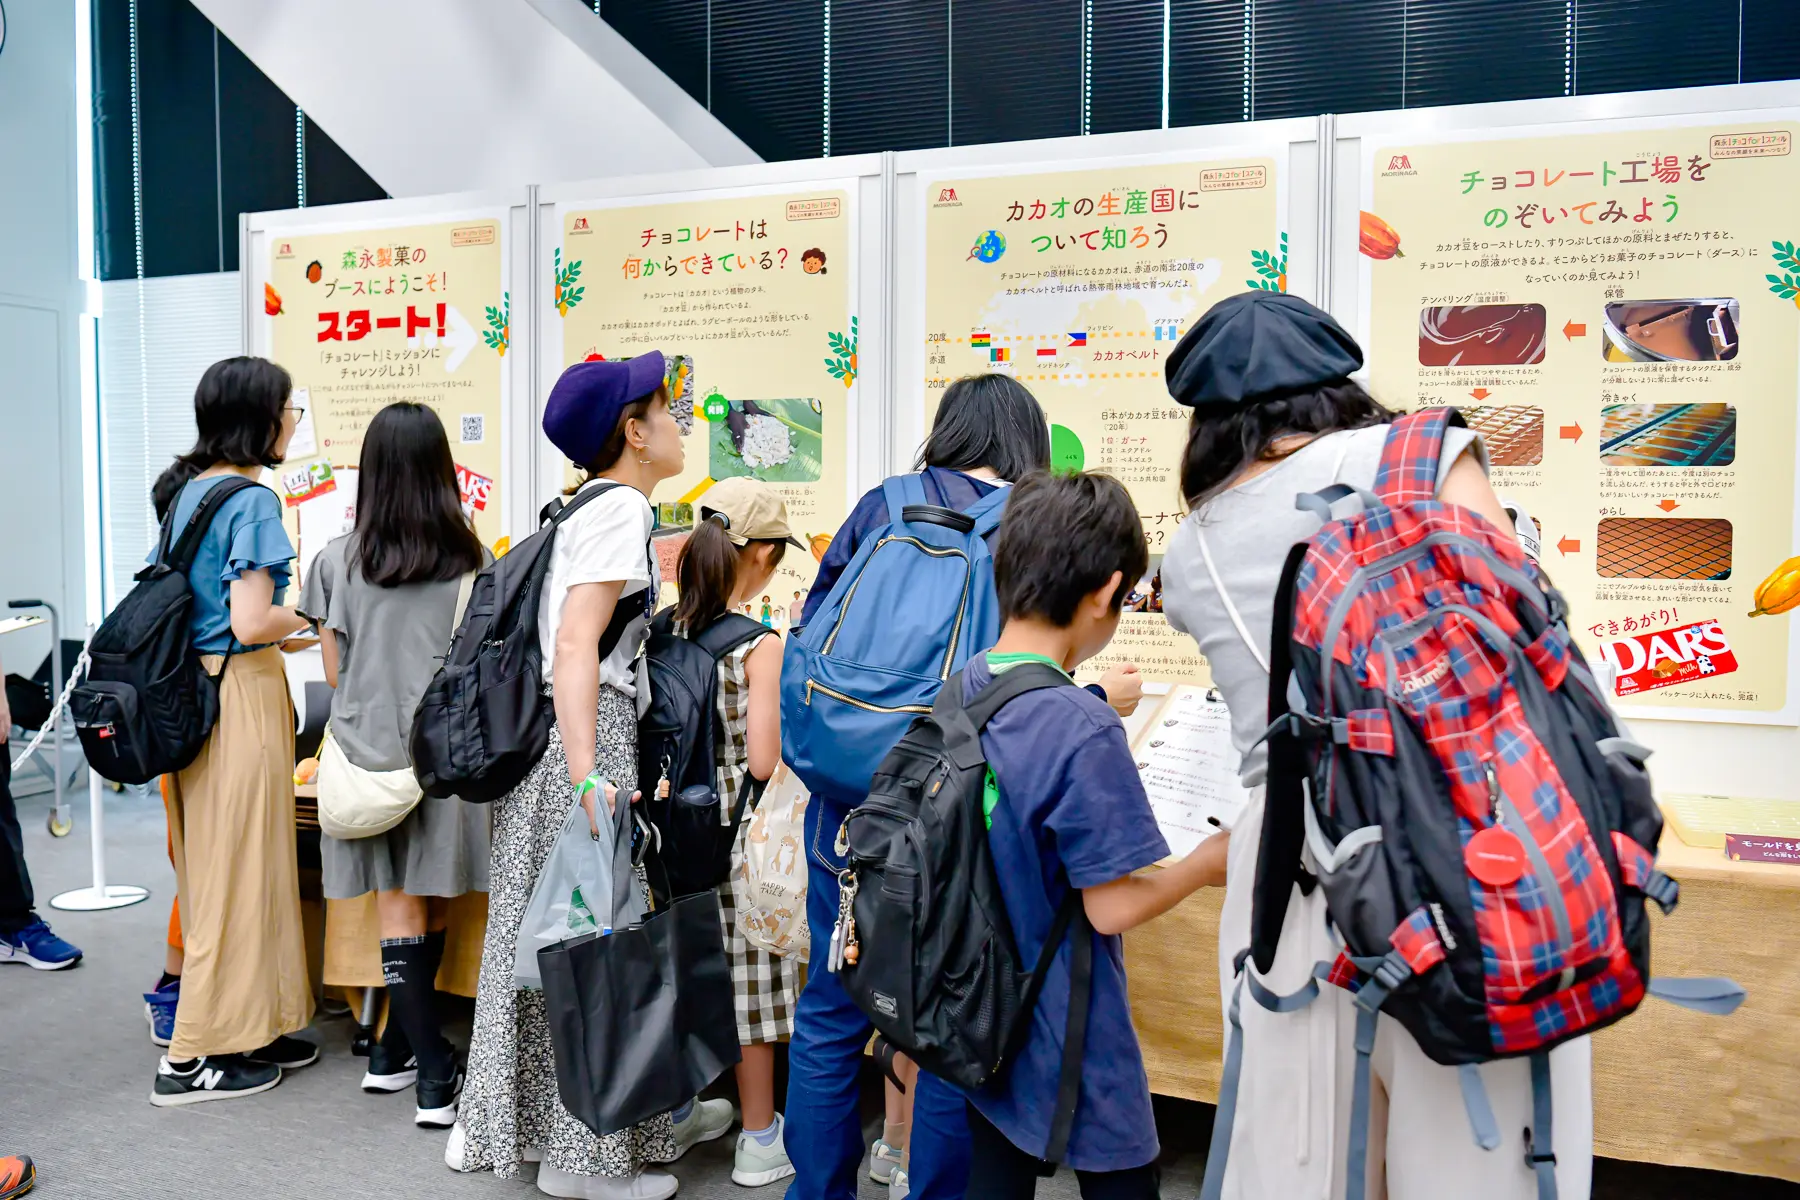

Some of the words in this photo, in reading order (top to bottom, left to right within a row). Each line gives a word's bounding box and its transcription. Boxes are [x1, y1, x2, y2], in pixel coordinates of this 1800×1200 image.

[1460, 155, 1711, 195] チョコレート工場を
[1006, 188, 1200, 223] カカオの生産国に
[1483, 194, 1680, 229] のぞいてみよう
[640, 218, 768, 248] チョコレートは
[1031, 223, 1169, 252] ついて知ろう
[1436, 231, 1735, 252] カカオ豆をローストしたり、すりつぶしてほかの原料とまぜたりすると、
[341, 246, 426, 270] 森永製菓の
[622, 247, 789, 280] 何からできている?
[325, 272, 447, 298] ブースにようこそ!
[1604, 288, 1625, 298] 保管
[317, 303, 446, 342] スタート!
[928, 333, 947, 342] 20度
[929, 355, 947, 365] 赤道
[1093, 348, 1160, 362] カカオベルト
[928, 379, 946, 389] 20度
[1418, 396, 1445, 405] 充てん
[1602, 393, 1636, 402] 冷きゃく
[1599, 507, 1626, 516] ゆらし
[1588, 607, 1680, 638] できあがり!
[1600, 621, 1731, 676] DARS
[760, 887, 783, 897] TAILS
[761, 881, 786, 893] HAPPY
